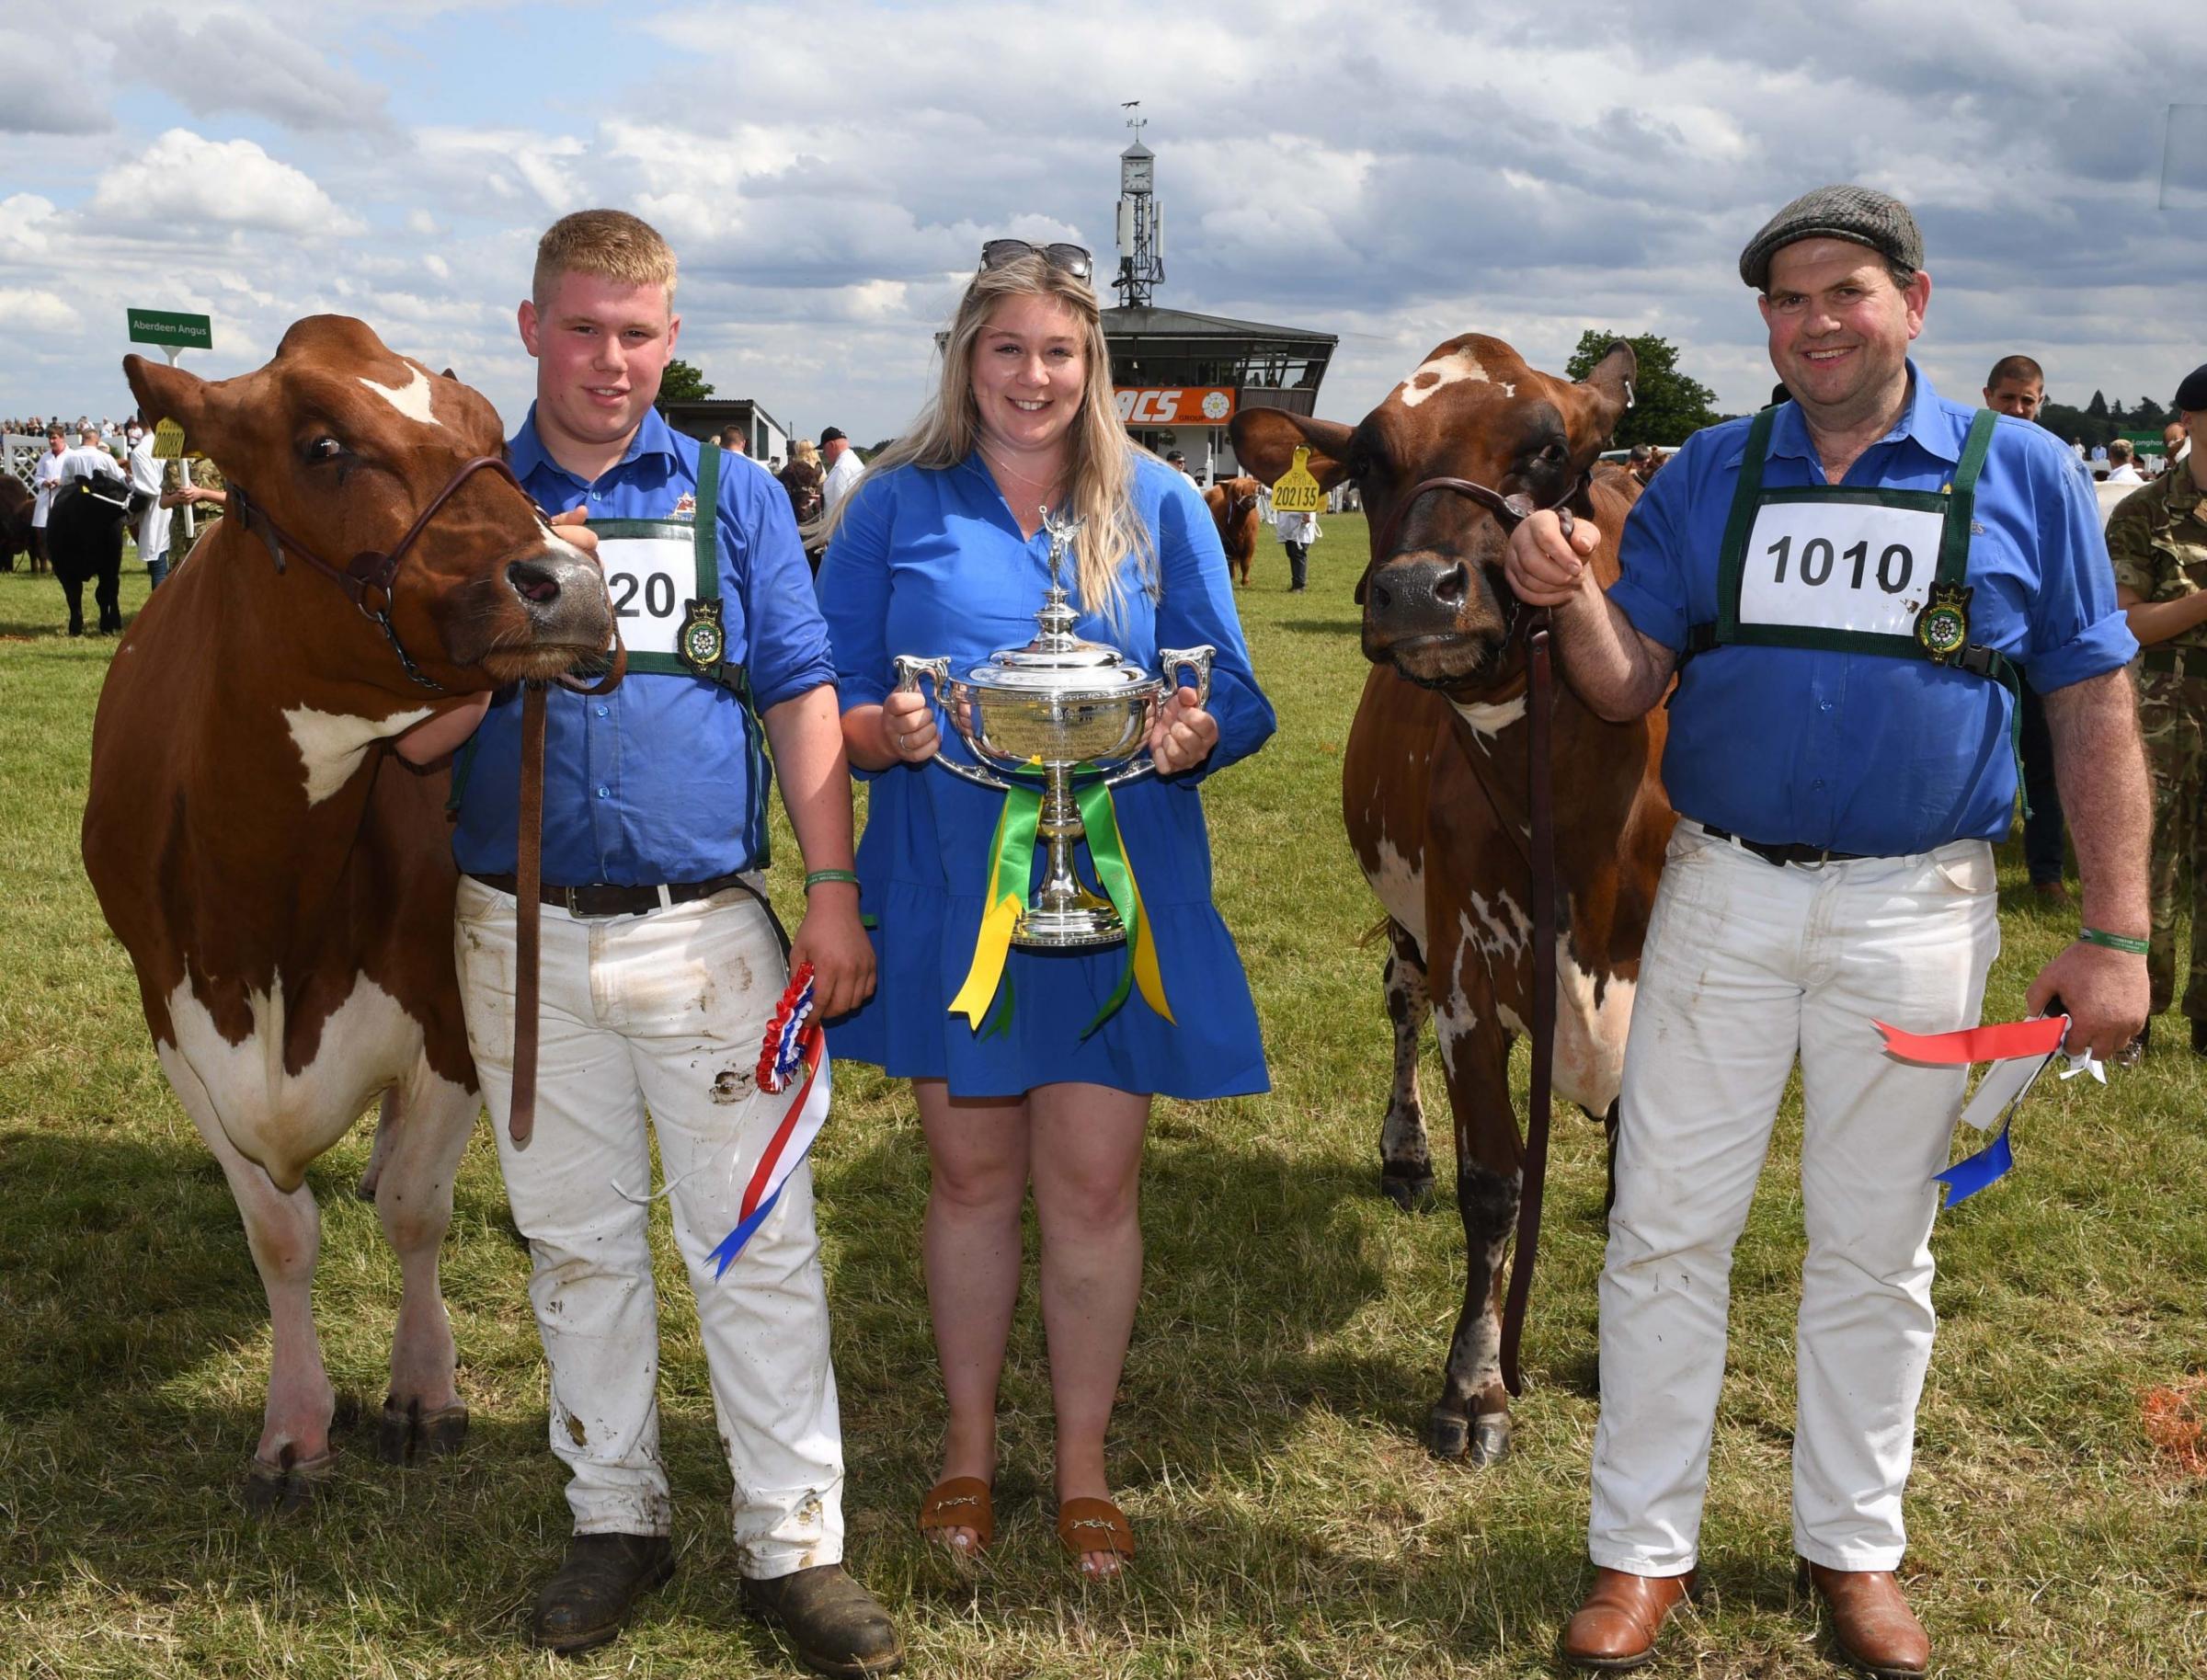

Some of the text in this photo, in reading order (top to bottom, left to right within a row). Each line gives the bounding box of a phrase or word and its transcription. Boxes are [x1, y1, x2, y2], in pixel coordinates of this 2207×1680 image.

[133, 320, 207, 337] Aberdeen Angus
[2133, 439, 2165, 448] Longhor
[1275, 486, 1317, 507] 202135
[1767, 535, 1914, 594] 1010
[609, 572, 676, 619] 20
